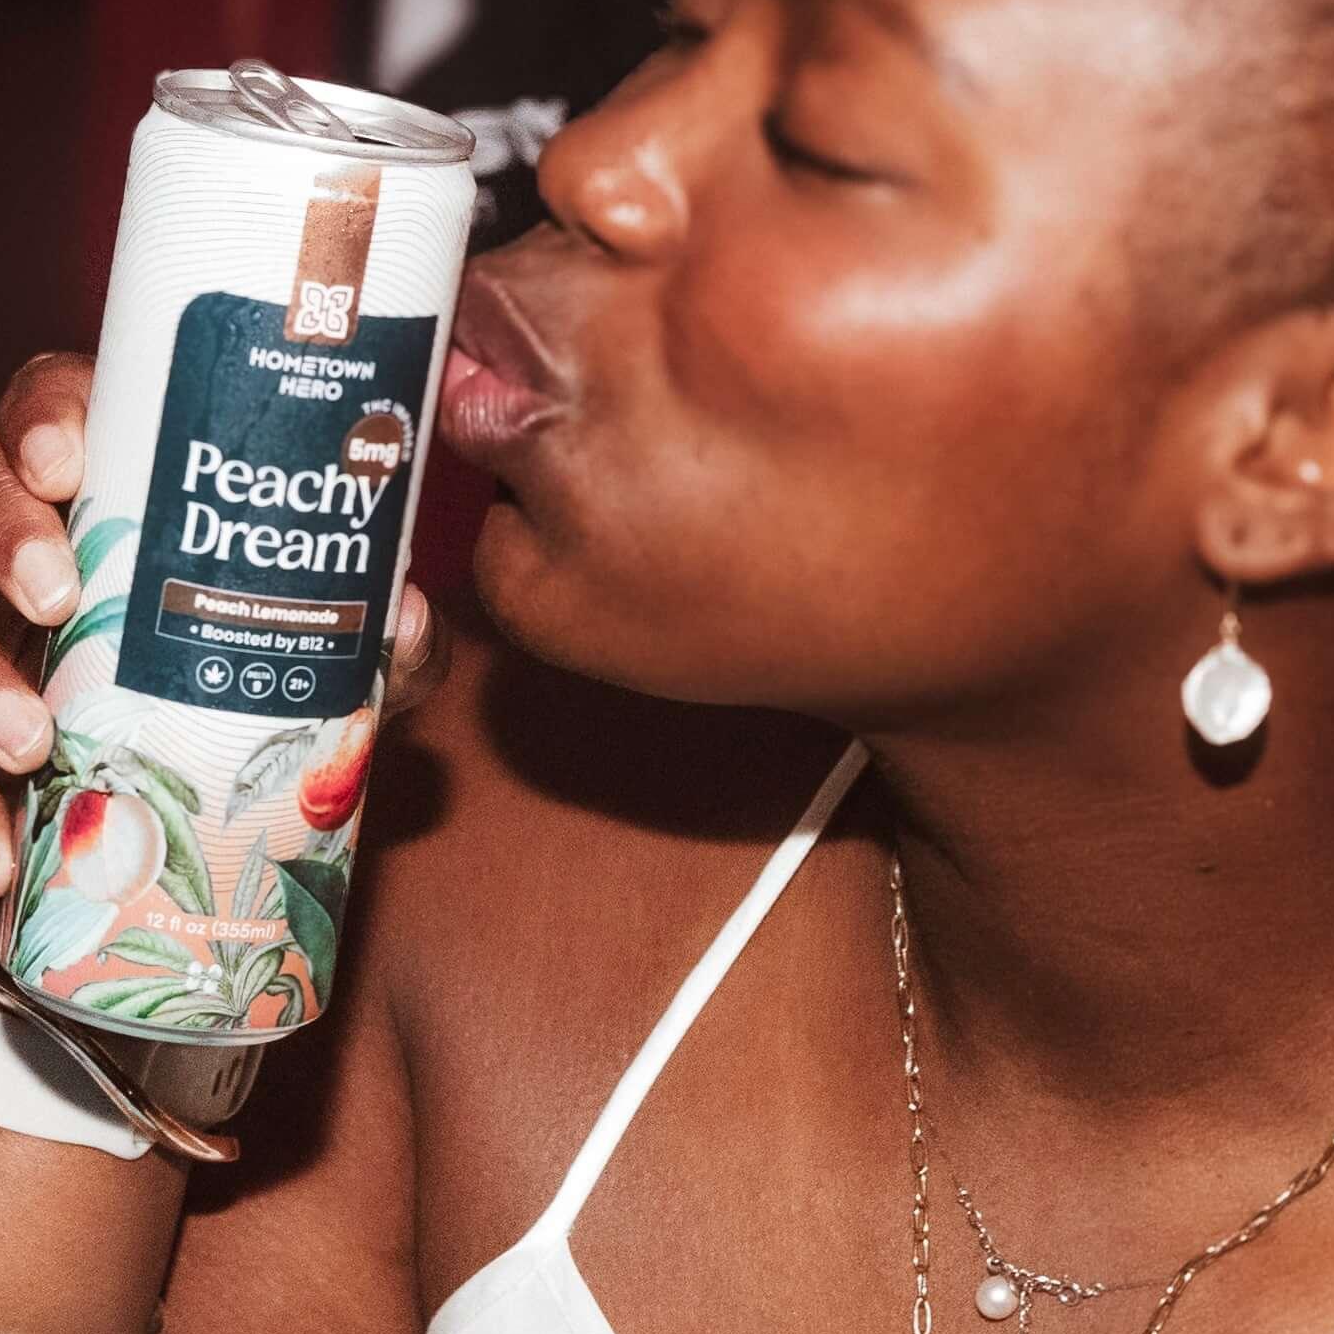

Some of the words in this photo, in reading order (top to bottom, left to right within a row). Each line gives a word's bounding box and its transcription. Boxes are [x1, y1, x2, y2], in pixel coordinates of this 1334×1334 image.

[249, 346, 376, 381] HOMETOWN
[278, 375, 343, 401] HERO
[348, 437, 400, 469] 5mg
[181, 440, 390, 529] Peachy
[179, 501, 371, 574] Dream
[194, 593, 251, 617] Peach
[251, 602, 340, 625] Lemonade
[200, 623, 272, 648] Boosted
[274, 632, 298, 654] by
[298, 636, 325, 652] B12
[288, 677, 310, 691] 21+
[146, 912, 165, 929] 12
[169, 916, 182, 932] fl
[186, 922, 207, 936] oz
[211, 920, 276, 939] (355ml)
